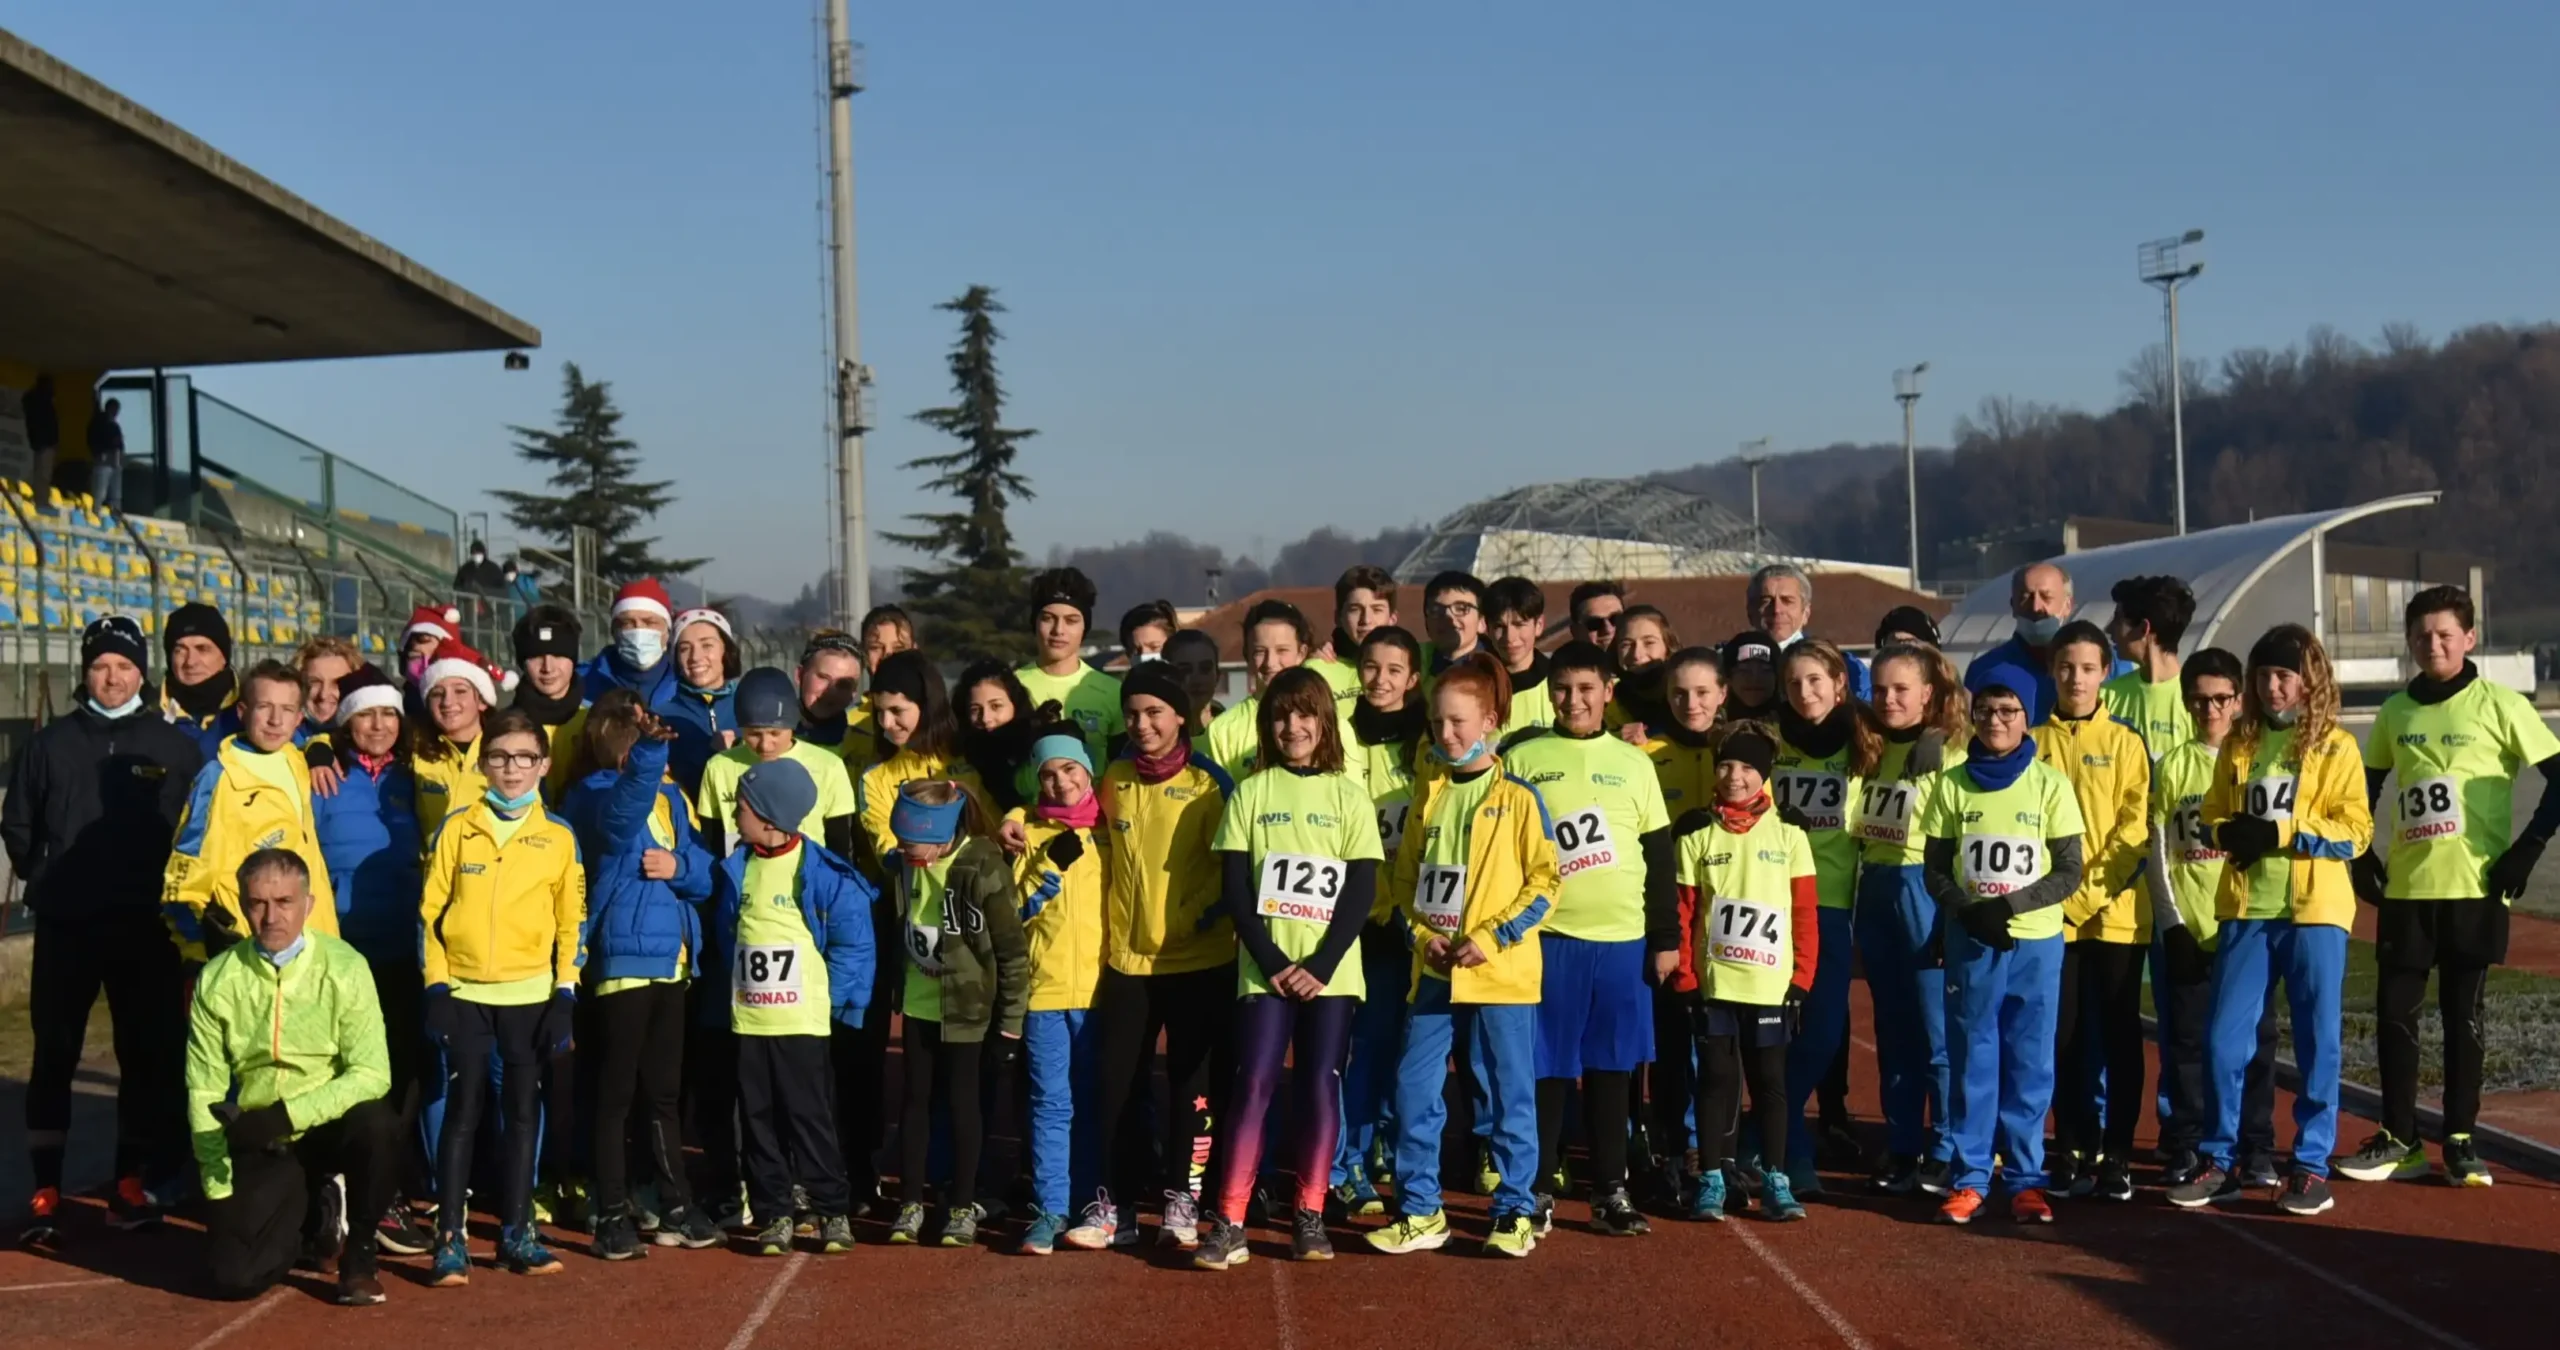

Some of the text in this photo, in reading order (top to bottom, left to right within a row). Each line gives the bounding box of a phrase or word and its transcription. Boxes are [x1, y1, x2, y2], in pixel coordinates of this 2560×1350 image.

[2397, 733, 2427, 746] AVIS
[1777, 776, 1841, 808] 173
[1862, 785, 1907, 820] 171
[2251, 782, 2294, 817] 04
[2398, 783, 2451, 822] 138
[1256, 812, 1292, 825] AVIS
[1555, 812, 1605, 852] 02
[1808, 815, 1840, 828] NAD
[2173, 810, 2202, 841] 13
[2405, 821, 2456, 840] CONAD
[1864, 825, 1904, 841] CONAD
[1559, 851, 1612, 877] CONAD
[1969, 840, 2034, 876] 103
[2185, 848, 2228, 861] CONA
[1272, 858, 1339, 899] 123
[1423, 870, 1467, 904] 17
[1977, 882, 2012, 896] CON
[1428, 913, 1458, 928] CON
[1720, 904, 1779, 945] 174
[738, 949, 795, 983] 187
[1723, 945, 1776, 966] CONAD
[745, 991, 798, 1005] CONAD
